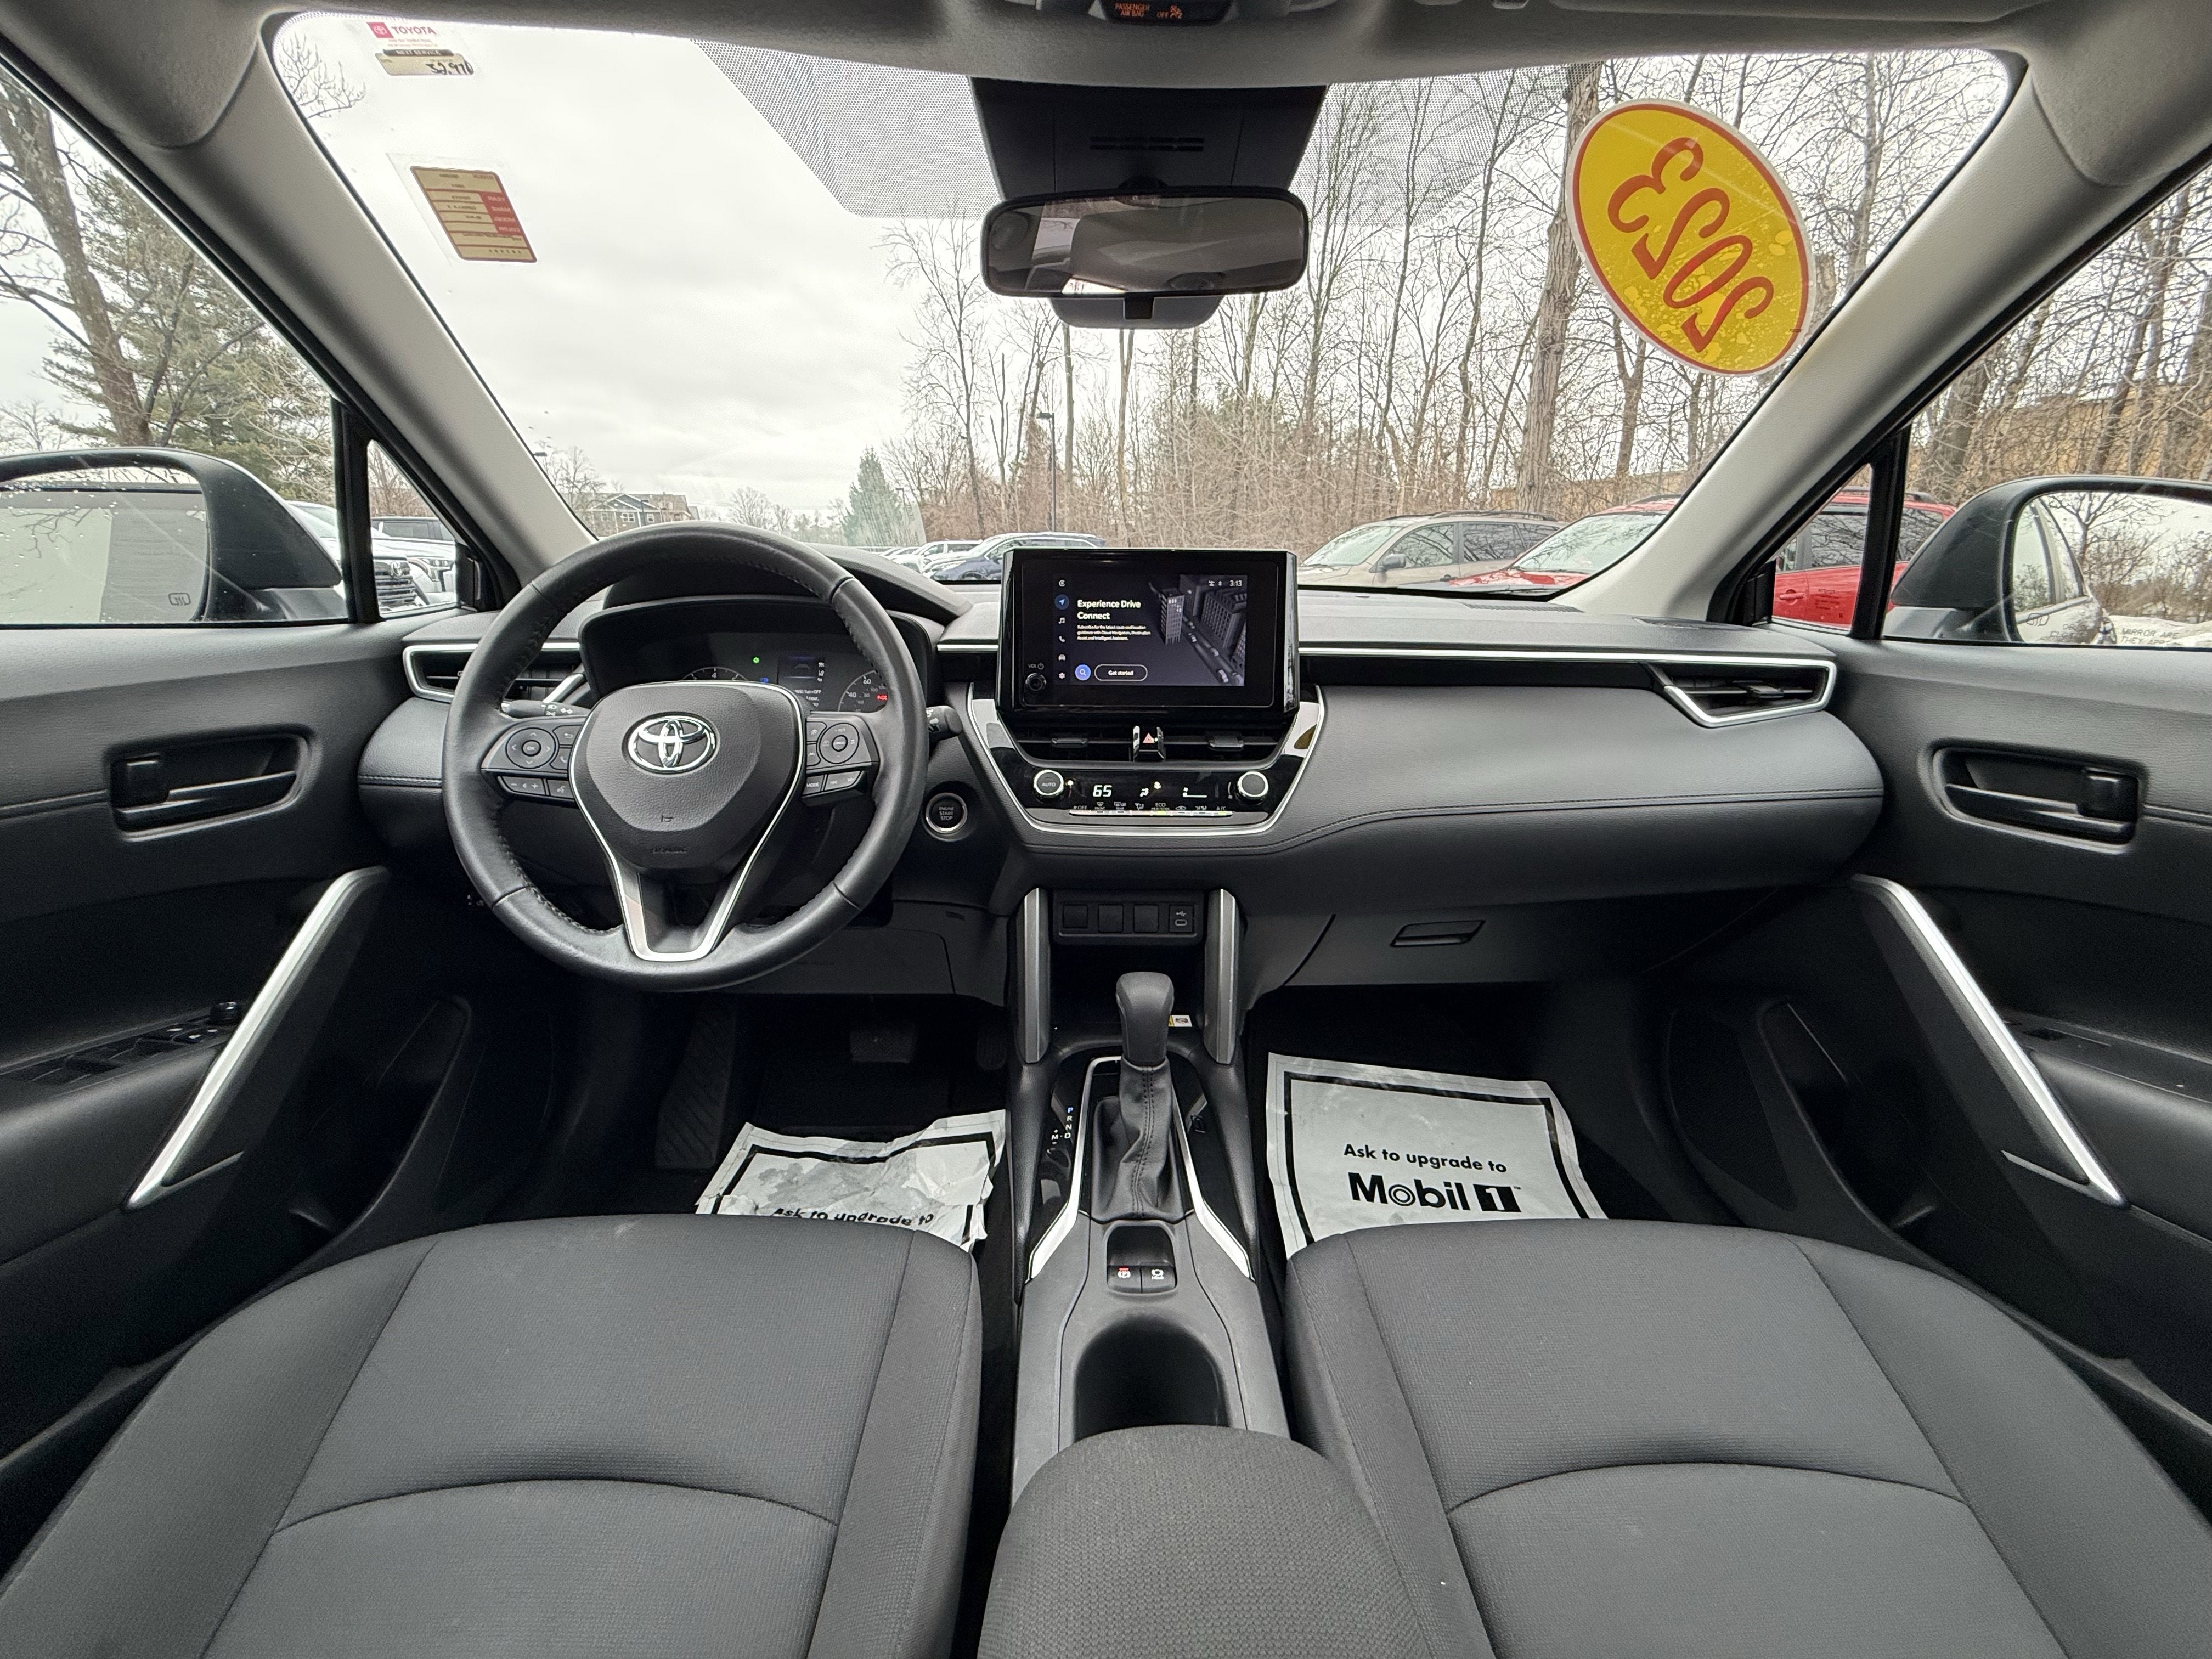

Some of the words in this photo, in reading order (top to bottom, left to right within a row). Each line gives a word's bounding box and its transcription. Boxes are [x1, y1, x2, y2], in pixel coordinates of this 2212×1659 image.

[1115, 3, 1150, 11] PASSENGER
[391, 26, 437, 35] TOYOTA
[1077, 600, 1120, 610] Experience
[1121, 600, 1141, 608] Drive
[1077, 611, 1111, 619] Connect
[2121, 628, 2156, 637] MIRROR
[1092, 785, 1113, 797] 65
[1344, 1143, 1376, 1159] Ask
[1382, 1149, 1400, 1161] to
[1406, 1154, 1483, 1171] upgrade
[1489, 1160, 1507, 1173] to
[1348, 1172, 1471, 1211] Mobil
[771, 1207, 802, 1217] Ask
[809, 1210, 828, 1220] to
[918, 1214, 934, 1226] to
